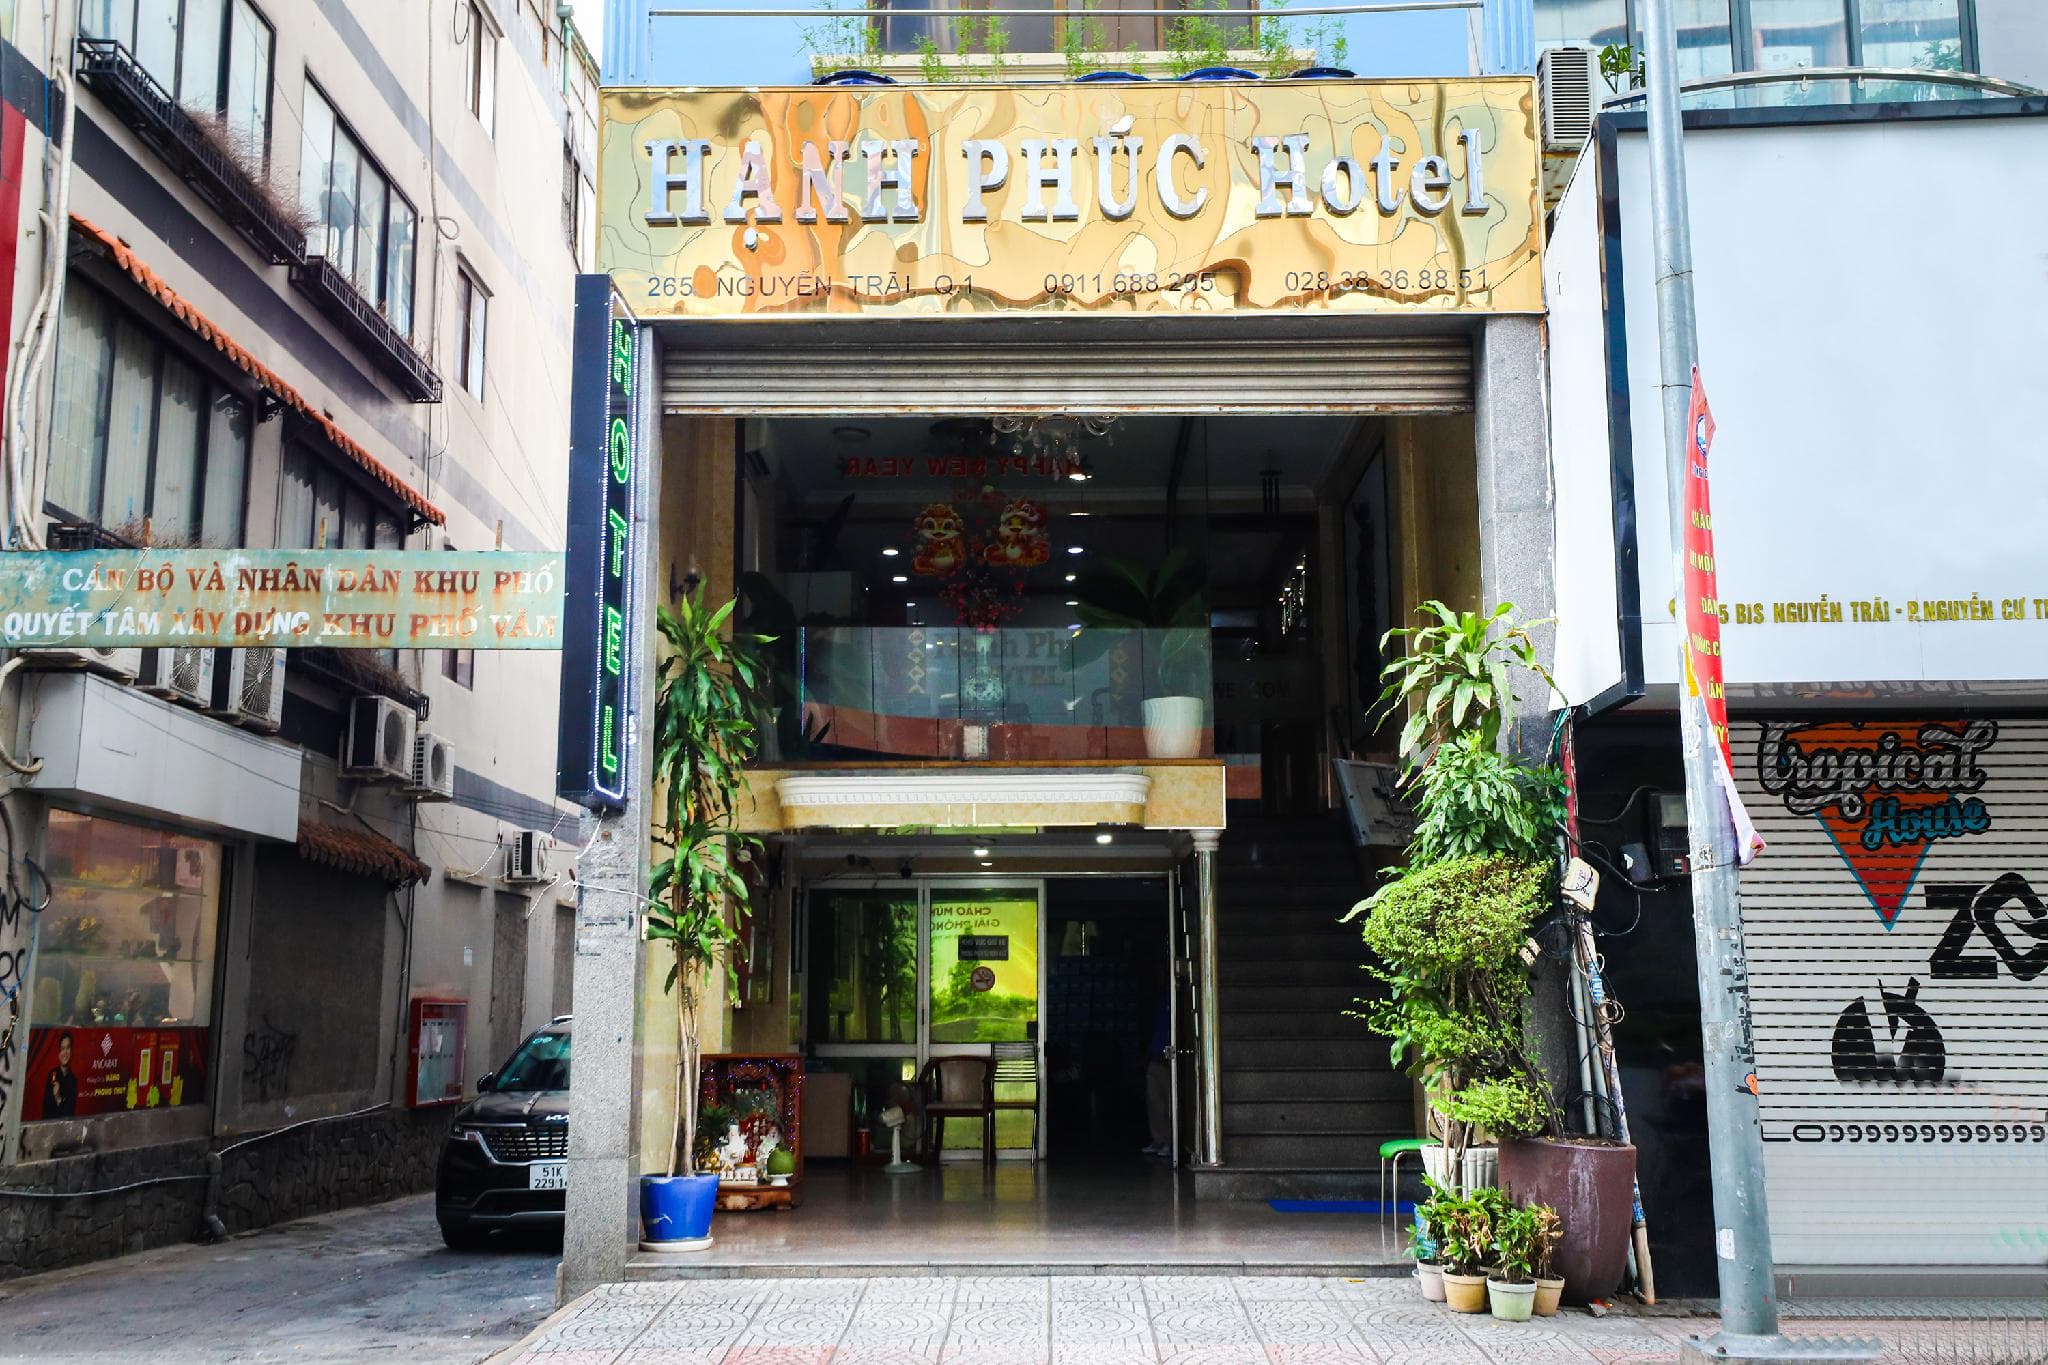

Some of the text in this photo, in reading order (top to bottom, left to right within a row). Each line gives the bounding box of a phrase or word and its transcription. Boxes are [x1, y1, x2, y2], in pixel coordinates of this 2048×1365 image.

[644, 115, 1490, 250] HẠNH PHÚC Hotel
[717, 269, 831, 297] NGUYỄN
[602, 319, 631, 773] HOTEL
[62, 561, 126, 591] CÁN
[137, 563, 175, 597] BỘ
[186, 561, 226, 592] VÀ
[237, 561, 324, 593] NHÂN
[337, 563, 402, 593] DÂN
[413, 570, 480, 594] KHU
[493, 559, 558, 593] PHỐ
[4, 603, 94, 640] QUYẾT
[102, 606, 161, 636] TÂM
[168, 606, 225, 636] XÂY
[234, 607, 310, 640] DỰNG
[320, 613, 397, 638] KHU
[409, 605, 483, 638] PHỐ
[1735, 603, 1765, 625] BIS
[1773, 593, 1843, 623] NGUYỄN
[1850, 596, 1890, 623] TRÃI
[2002, 597, 2026, 621] CƯ
[1757, 719, 1998, 821] Tropical
[1860, 796, 1991, 850] House
[542, 1167, 563, 1177] 51K
